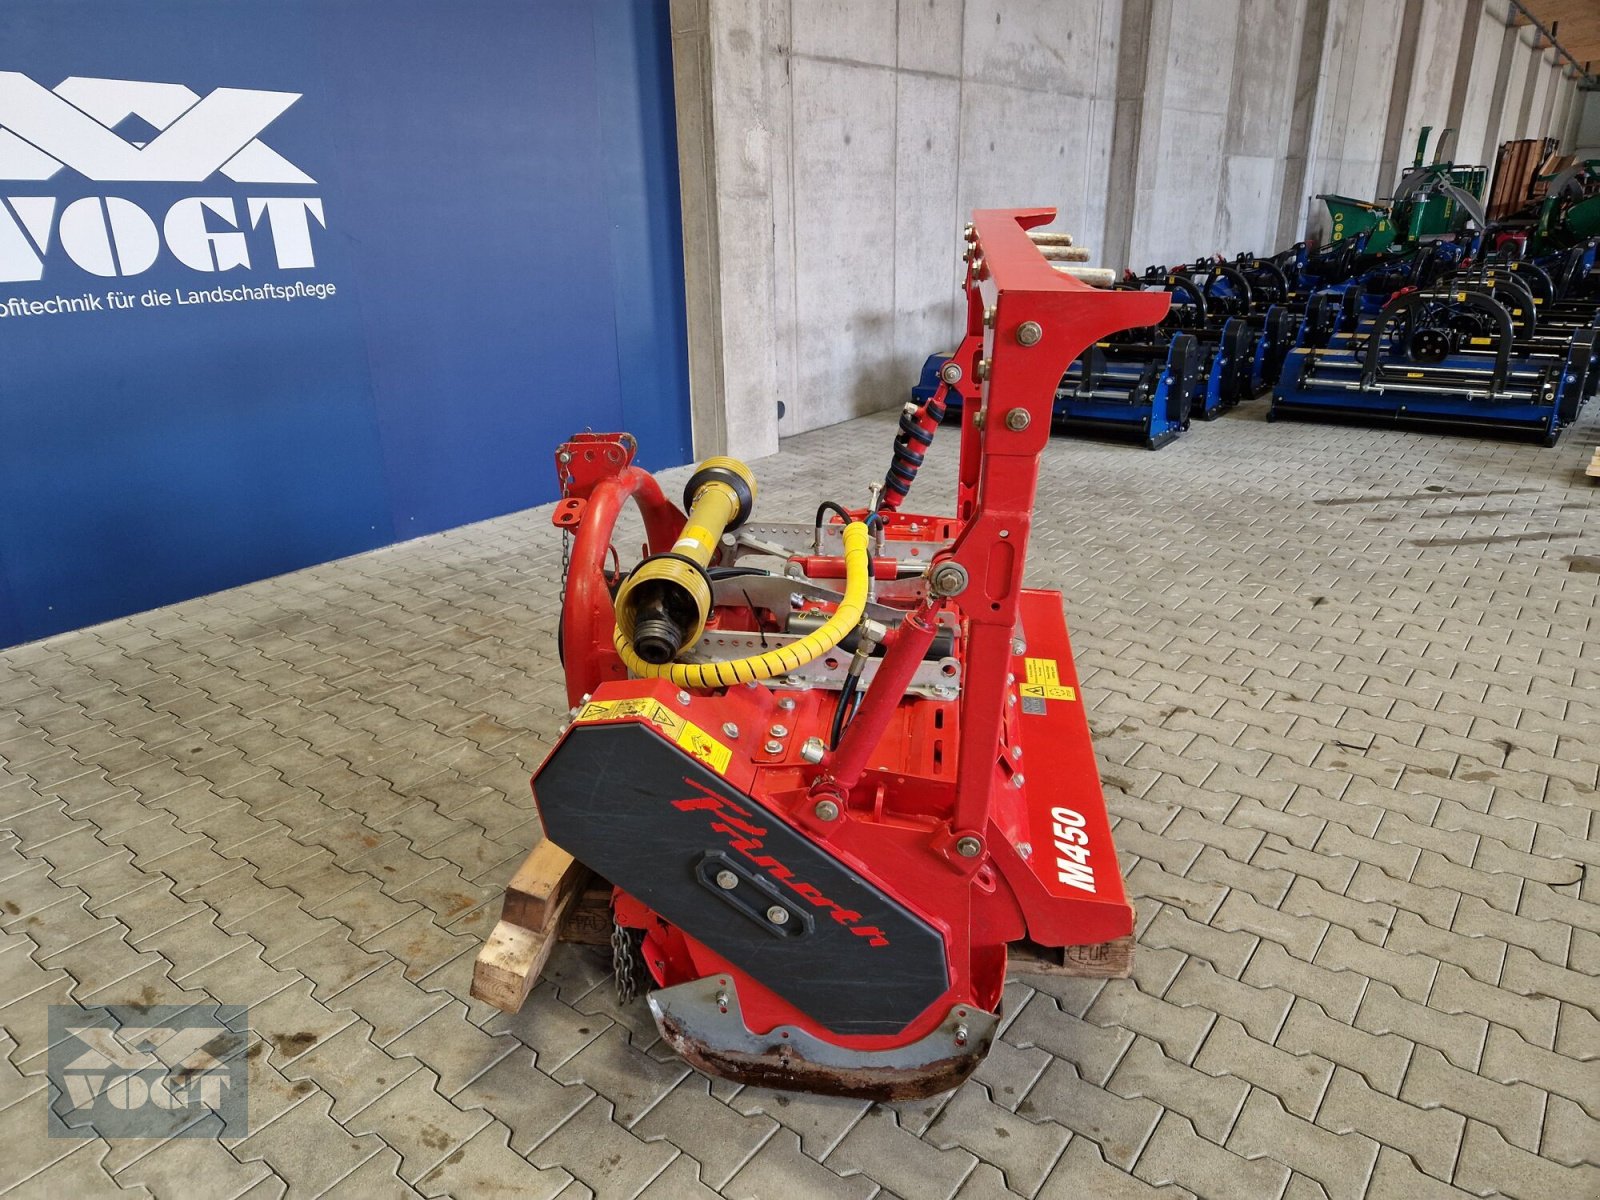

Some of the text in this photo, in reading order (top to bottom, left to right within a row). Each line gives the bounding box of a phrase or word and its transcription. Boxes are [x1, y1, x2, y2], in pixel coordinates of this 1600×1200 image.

[107, 291, 137, 309] für
[140, 288, 172, 307] die
[175, 281, 337, 305] Landschaftspflege
[1051, 807, 1097, 894] M450
